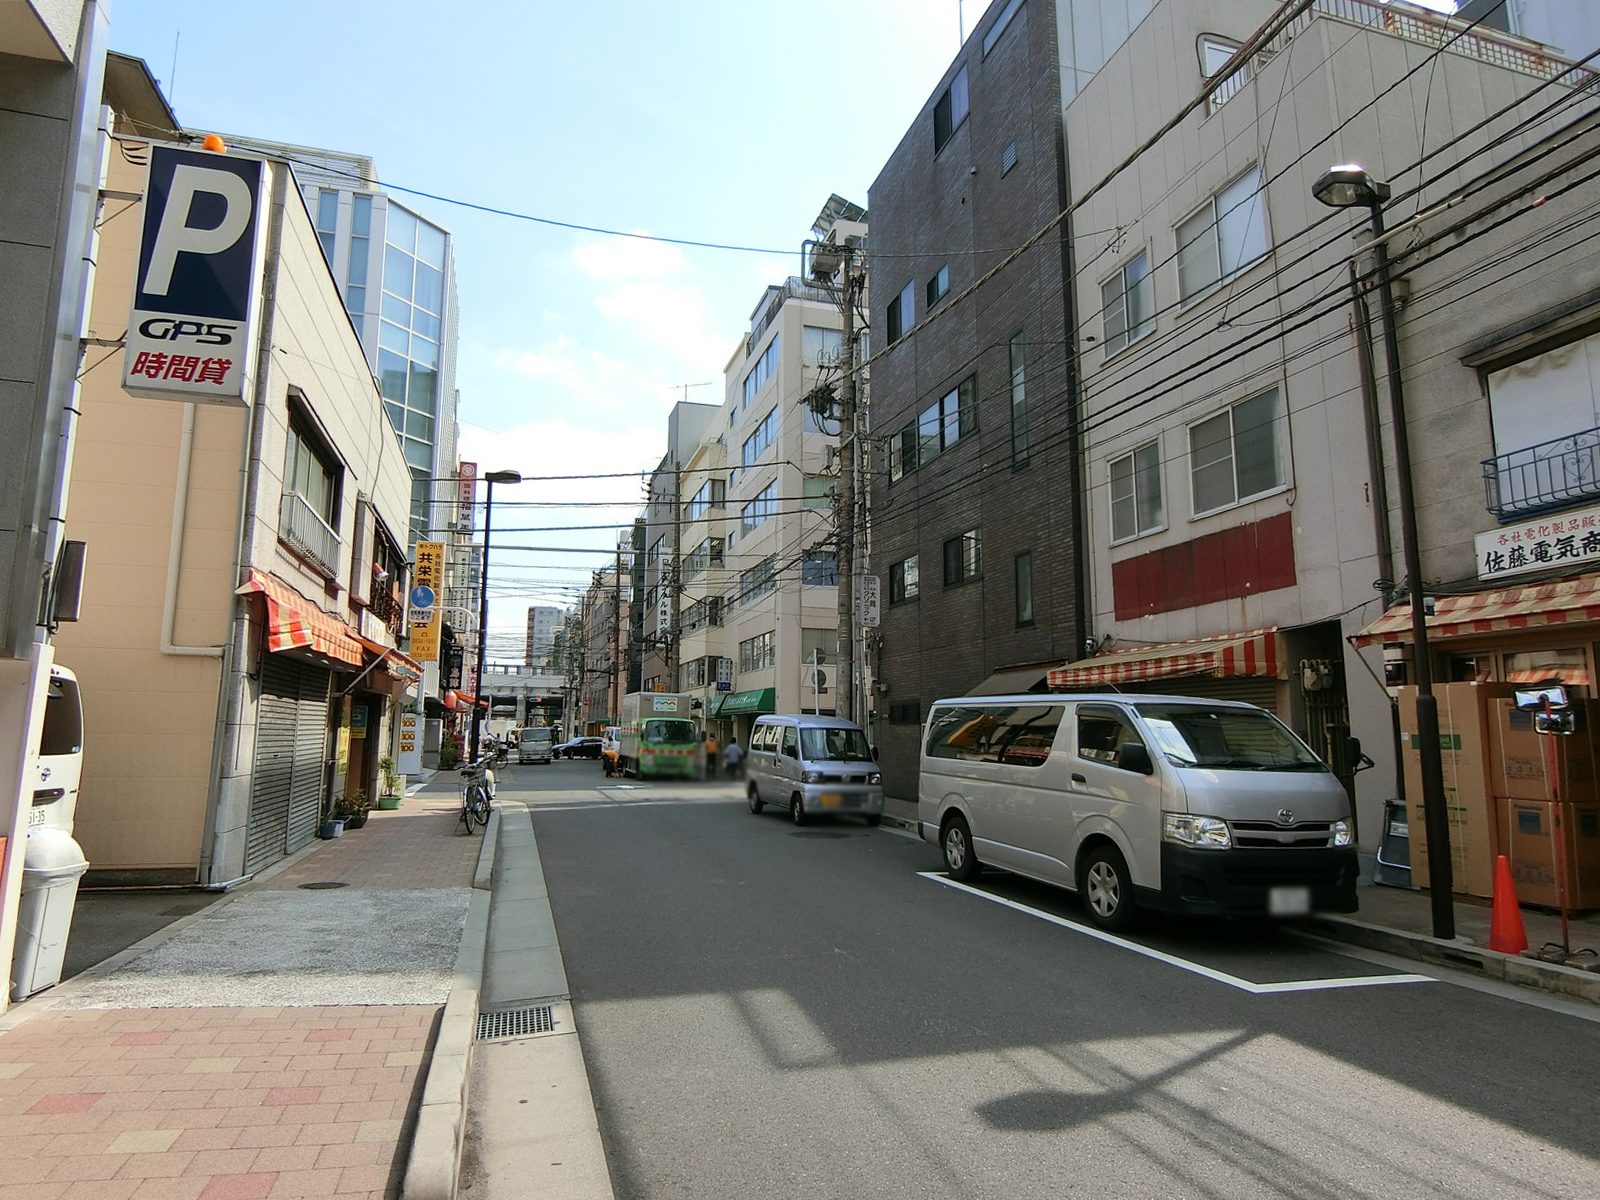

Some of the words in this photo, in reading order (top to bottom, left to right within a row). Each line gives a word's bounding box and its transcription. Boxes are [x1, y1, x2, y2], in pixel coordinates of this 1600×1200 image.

[142, 164, 253, 296] P
[138, 318, 238, 346] GPS
[130, 352, 233, 385] 時間貸
[1497, 515, 1600, 545] 各社電化製品販
[402, 719, 416, 727] 100
